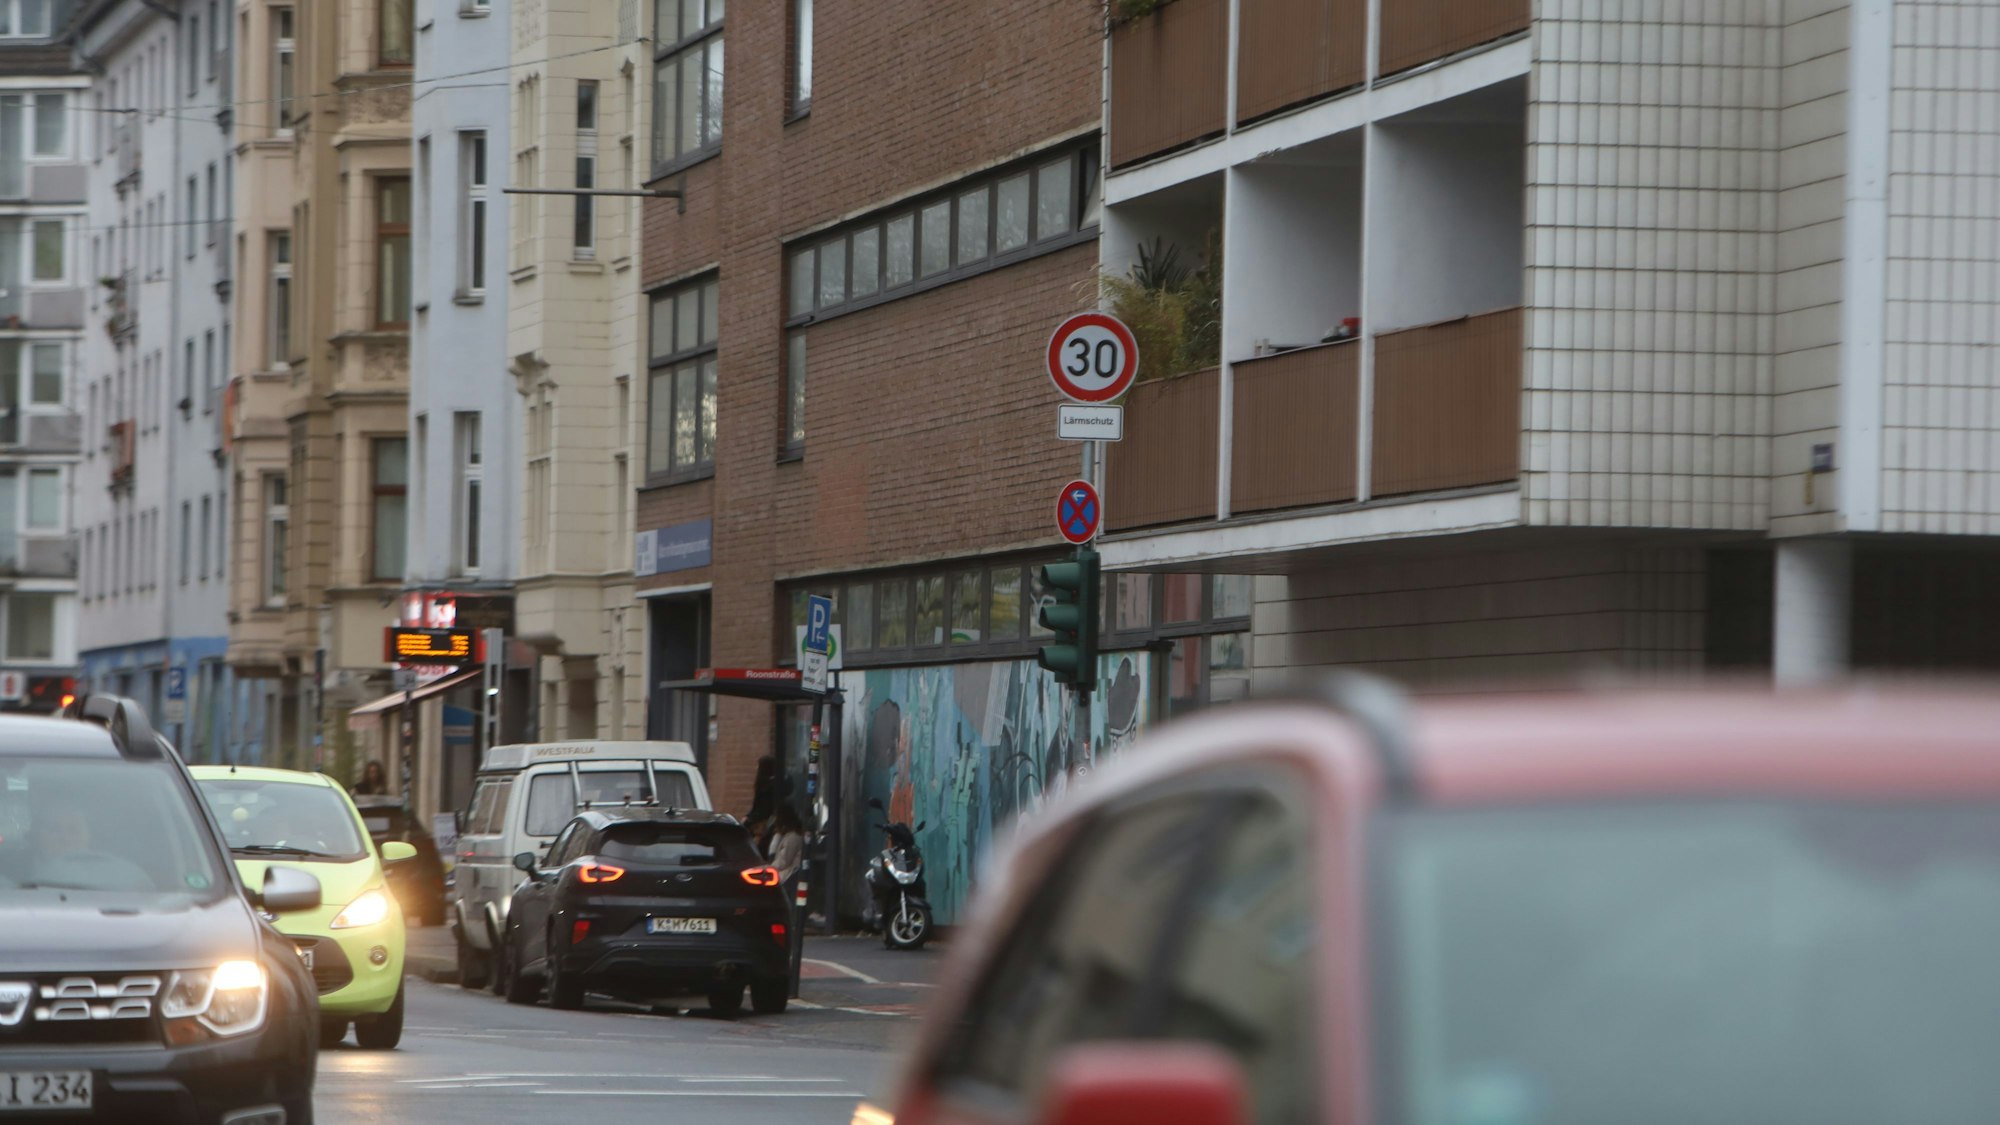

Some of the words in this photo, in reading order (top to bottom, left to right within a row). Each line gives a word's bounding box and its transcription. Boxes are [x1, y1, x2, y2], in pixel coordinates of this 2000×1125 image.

[1067, 337, 1118, 378] 30
[1063, 415, 1114, 426] Lärmschutz
[811, 604, 826, 643] P
[745, 670, 796, 679] Roonstraße
[536, 746, 595, 756] WESTFALIA
[32, 1073, 90, 1104] 234
